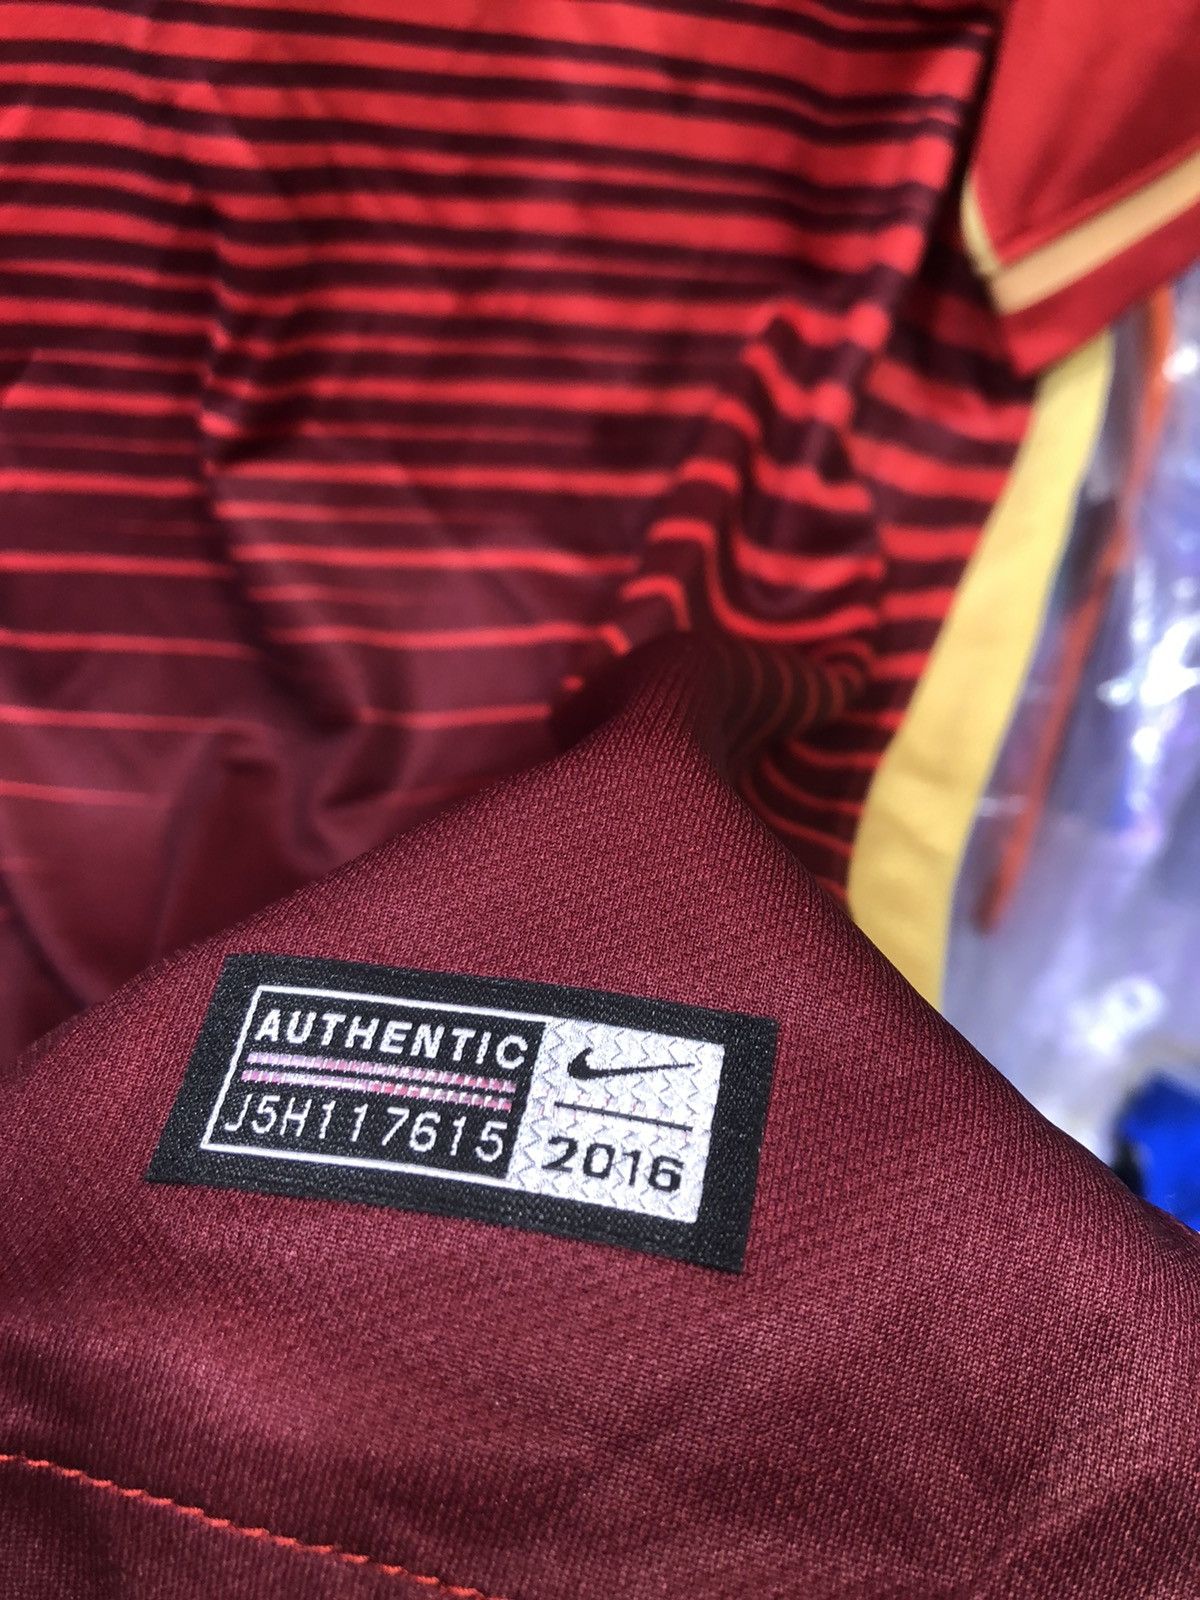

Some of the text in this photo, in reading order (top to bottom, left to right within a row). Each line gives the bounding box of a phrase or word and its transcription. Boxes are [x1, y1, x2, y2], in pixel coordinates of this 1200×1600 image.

[254, 1008, 529, 1070] AUTHENTIC
[223, 1093, 508, 1163] J5H117615
[541, 1134, 685, 1193] 2016
